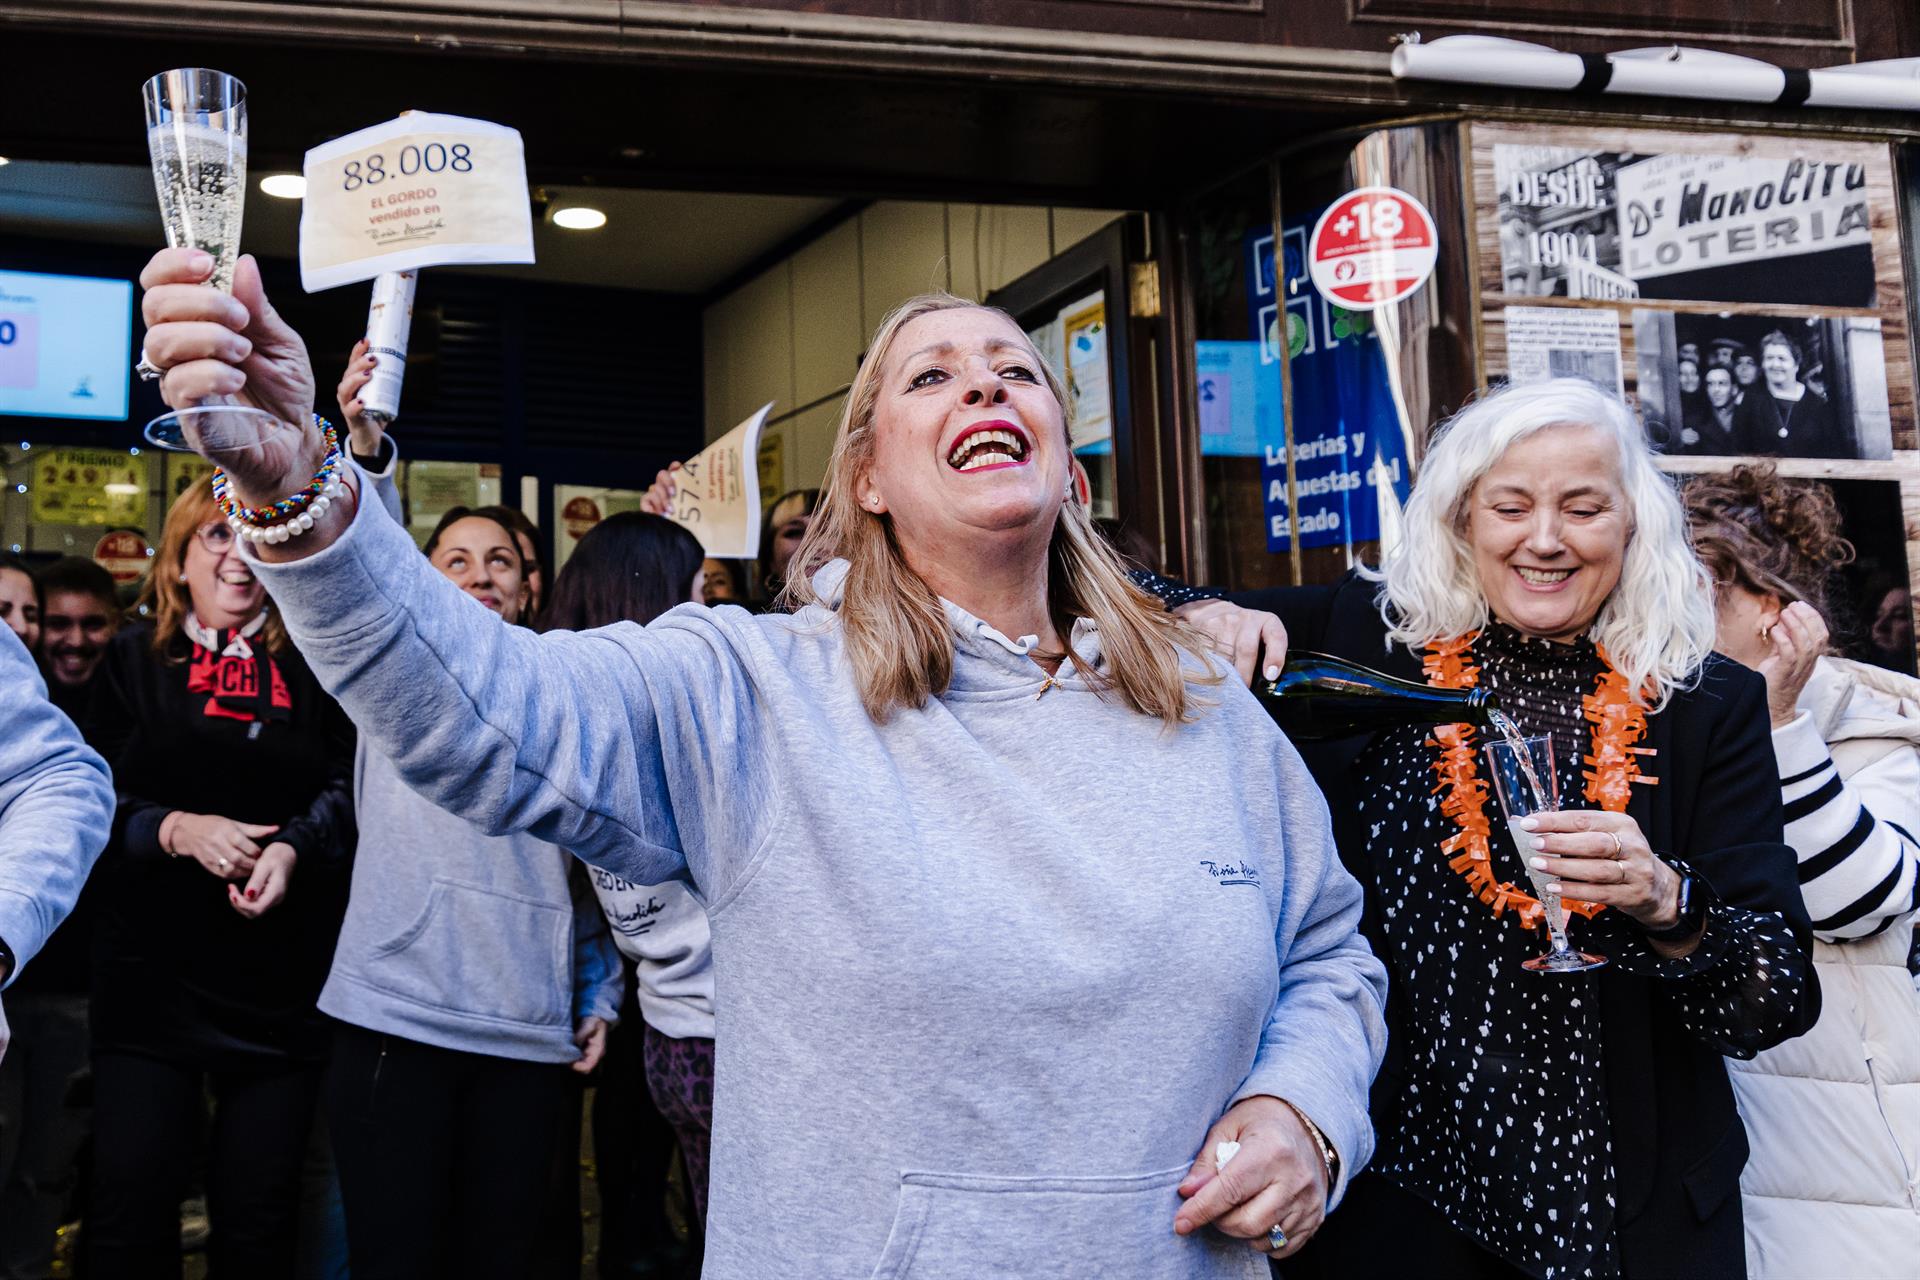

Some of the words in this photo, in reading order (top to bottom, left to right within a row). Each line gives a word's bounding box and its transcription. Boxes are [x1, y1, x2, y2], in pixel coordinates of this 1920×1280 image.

[343, 143, 473, 191] 88.008
[368, 207, 421, 225] vendido
[423, 204, 441, 215] en
[371, 197, 384, 209] EL
[388, 188, 437, 206] GORDO
[1333, 199, 1404, 241] +18
[1265, 433, 1347, 466] Loerías
[1271, 507, 1341, 538] Esado
